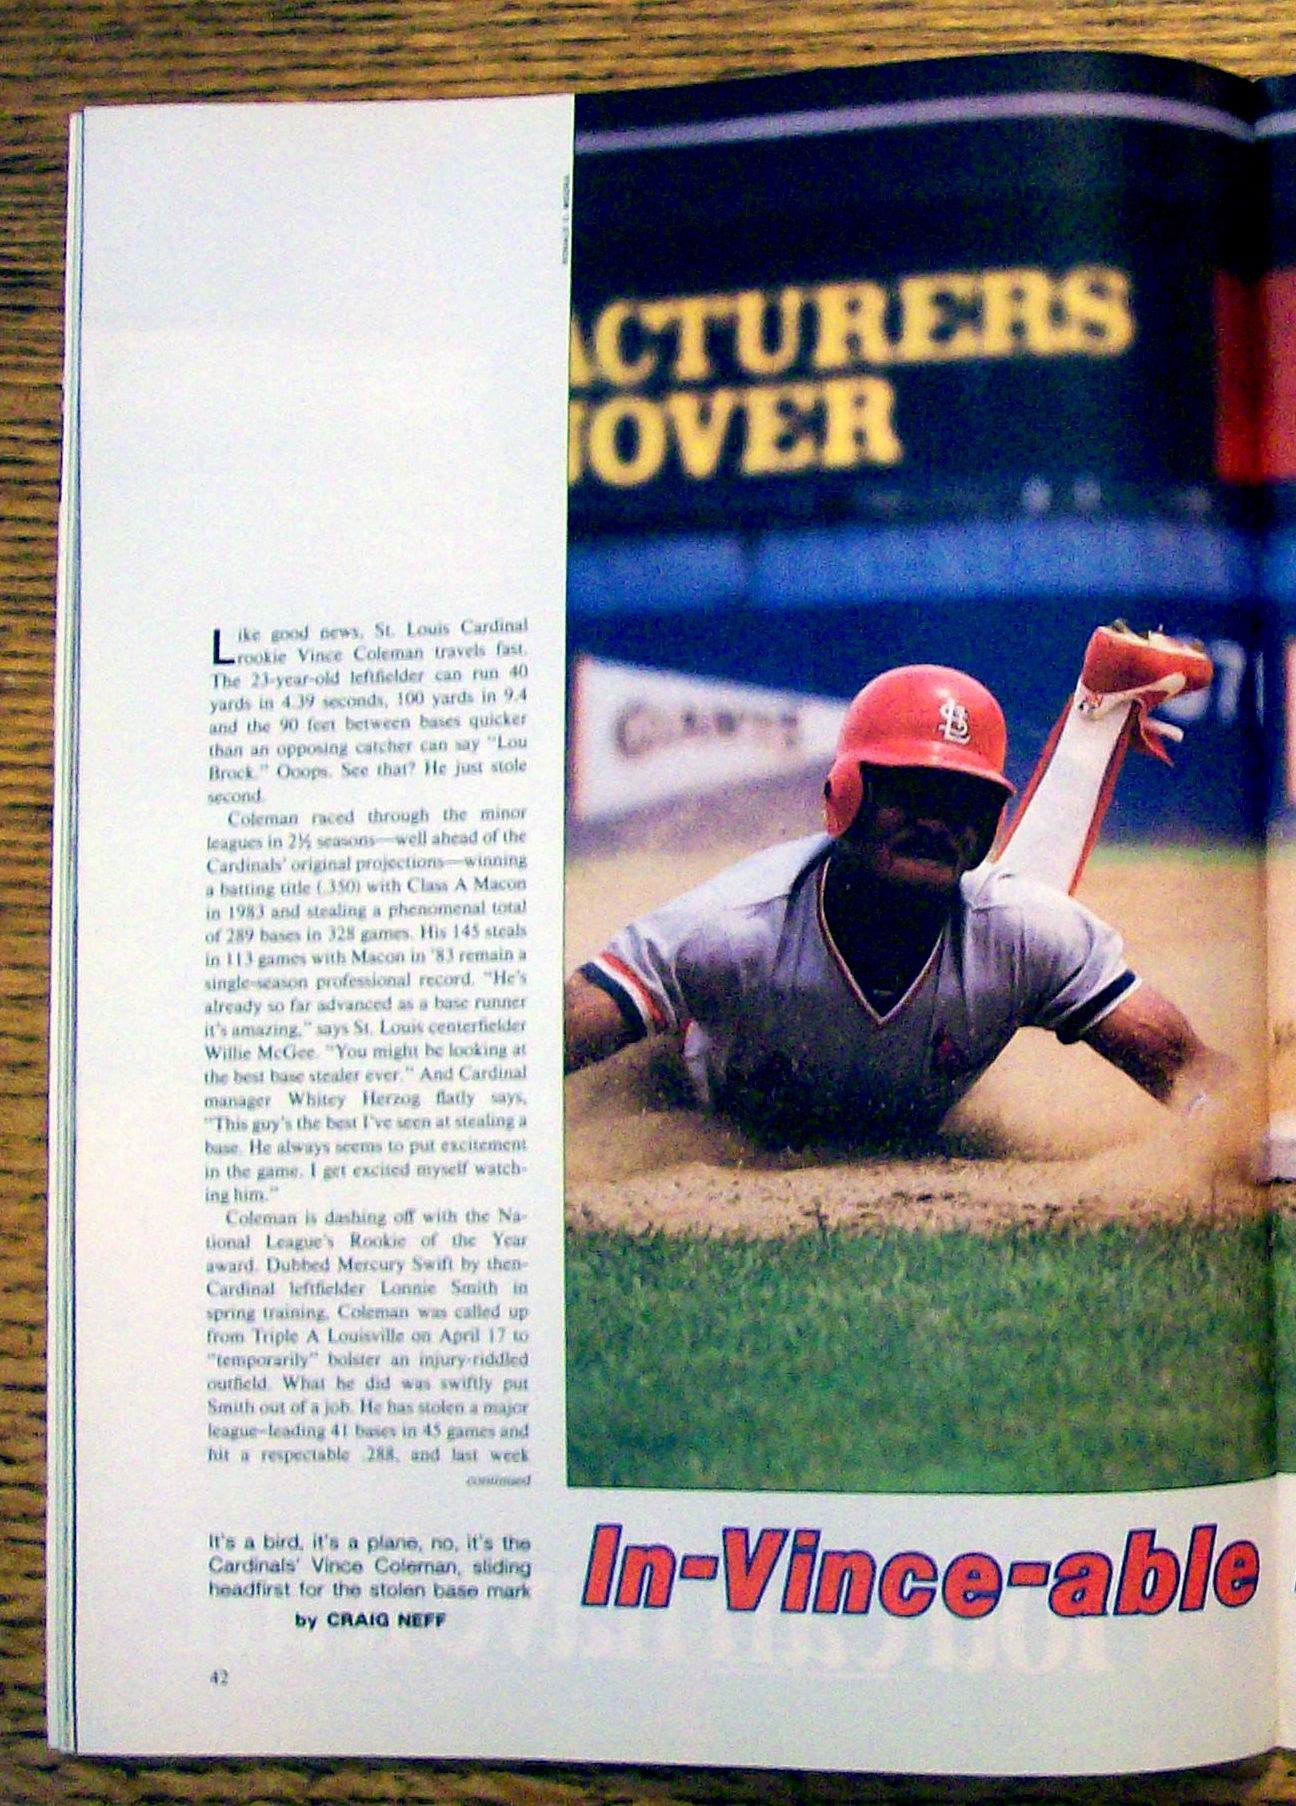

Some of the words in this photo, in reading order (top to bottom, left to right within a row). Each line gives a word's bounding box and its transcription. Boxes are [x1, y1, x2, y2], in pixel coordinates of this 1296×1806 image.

[270, 625, 309, 644] good
[319, 627, 363, 640] news,
[374, 623, 394, 637] St.
[406, 620, 450, 637] Louis
[460, 618, 528, 635] Cardinal
[237, 651, 286, 665] rookie
[297, 646, 342, 663] Vince
[353, 644, 424, 661] Coleman
[434, 643, 486, 658] travels
[496, 640, 526, 656] fast.
[213, 672, 240, 689] The
[251, 670, 339, 689] 23-year-old
[350, 667, 424, 684] leftfielder
[434, 670, 462, 682] can
[472, 669, 499, 680] run
[509, 663, 528, 678] 40
[210, 697, 251, 714] yards
[258, 697, 274, 710] in
[281, 694, 315, 709] 4.39
[322, 693, 388, 710] seconds,
[398, 691, 424, 705] 100
[432, 690, 474, 707] yards
[481, 690, 496, 703] in
[503, 687, 527, 701] 9.4
[208, 719, 237, 735] and
[246, 718, 270, 733] the
[279, 717, 299, 732] 90
[307, 717, 335, 732] feet
[345, 714, 410, 731] between
[419, 713, 461, 729] bases
[468, 711, 526, 730] quicker
[208, 742, 243, 758] than
[250, 745, 269, 756] an
[276, 742, 347, 759] opposing
[354, 739, 412, 754] catcher
[419, 741, 448, 752] can
[454, 739, 480, 753] say
[487, 733, 527, 750] "Lou
[208, 763, 269, 780] Brock."
[276, 763, 331, 781] Ooops.
[341, 763, 368, 778] See
[376, 761, 415, 777] that?
[424, 759, 446, 775] He
[455, 761, 483, 776] just
[491, 757, 526, 773] stole
[207, 788, 265, 804] second.
[227, 809, 298, 827] Coleman
[311, 810, 354, 825] raced
[367, 807, 429, 826] through
[442, 807, 467, 822] the
[480, 806, 527, 820] minor
[206, 909, 220, 920] in
[229, 903, 264, 920] 1983
[270, 903, 300, 919] and
[306, 902, 366, 922] stealing
[372, 906, 381, 917] a
[388, 900, 486, 919] phenomenal
[492, 898, 526, 915] total
[204, 973, 308, 993] single-season
[315, 972, 411, 990] professional
[419, 971, 474, 987] record.
[483, 969, 527, 985] "He's
[204, 1045, 251, 1061] Willie
[257, 1043, 318, 1060] McGee.
[325, 1043, 367, 1059] "You
[372, 1043, 418, 1061] might
[424, 1042, 443, 1057] be
[448, 1042, 507, 1059] looking
[512, 1044, 526, 1056] at
[204, 1096, 271, 1111] manager
[288, 1091, 346, 1110] Whitey
[362, 1089, 421, 1109] Herzog
[435, 1089, 474, 1107] flatly
[491, 1092, 526, 1106] says,
[225, 1209, 297, 1226] Coleman
[305, 1209, 317, 1225] is
[324, 1208, 386, 1228] dashing
[393, 1207, 416, 1224] off
[422, 1208, 457, 1223] with
[465, 1208, 490, 1223] the
[498, 1207, 526, 1223] Na-
[205, 1234, 250, 1249] tional
[266, 1233, 334, 1252] League's
[350, 1231, 406, 1248] Rookie
[420, 1231, 438, 1247] of
[452, 1232, 476, 1247] the
[492, 1231, 526, 1247] Year
[206, 1257, 262, 1273] award.
[266, 1256, 330, 1273] Dubbed
[337, 1256, 404, 1275] Mercury
[412, 1256, 452, 1271] Swift
[460, 1256, 479, 1273] by
[486, 1256, 527, 1271] then-
[206, 1280, 274, 1297] Cardinal
[289, 1279, 365, 1296] leftfielder
[380, 1280, 436, 1295] Lonnie
[450, 1279, 498, 1295] Smith
[512, 1282, 528, 1294] in
[209, 1533, 236, 1550] It's
[243, 1536, 255, 1550] a
[263, 1533, 304, 1551] bird,
[312, 1533, 339, 1550] it's
[347, 1536, 358, 1550] a
[367, 1535, 422, 1553] plane,
[431, 1537, 458, 1552] no,
[467, 1534, 493, 1551] it's
[502, 1535, 531, 1551] the
[208, 1555, 299, 1574] Cardinals'
[311, 1556, 363, 1574] Vince
[374, 1556, 461, 1576] Coleman,
[472, 1558, 531, 1579] sliding
[582, 1522, 1261, 1618] In-Vince-able
[208, 1580, 290, 1597] headfirst
[299, 1581, 324, 1597] for
[332, 1581, 361, 1598] the
[370, 1581, 426, 1598] stolen
[433, 1582, 479, 1598] base
[486, 1583, 530, 1599] mark
[295, 1612, 317, 1630] by
[326, 1612, 389, 1627] CRAIG
[397, 1612, 446, 1627] NEFF
[209, 1669, 228, 1685] 42
